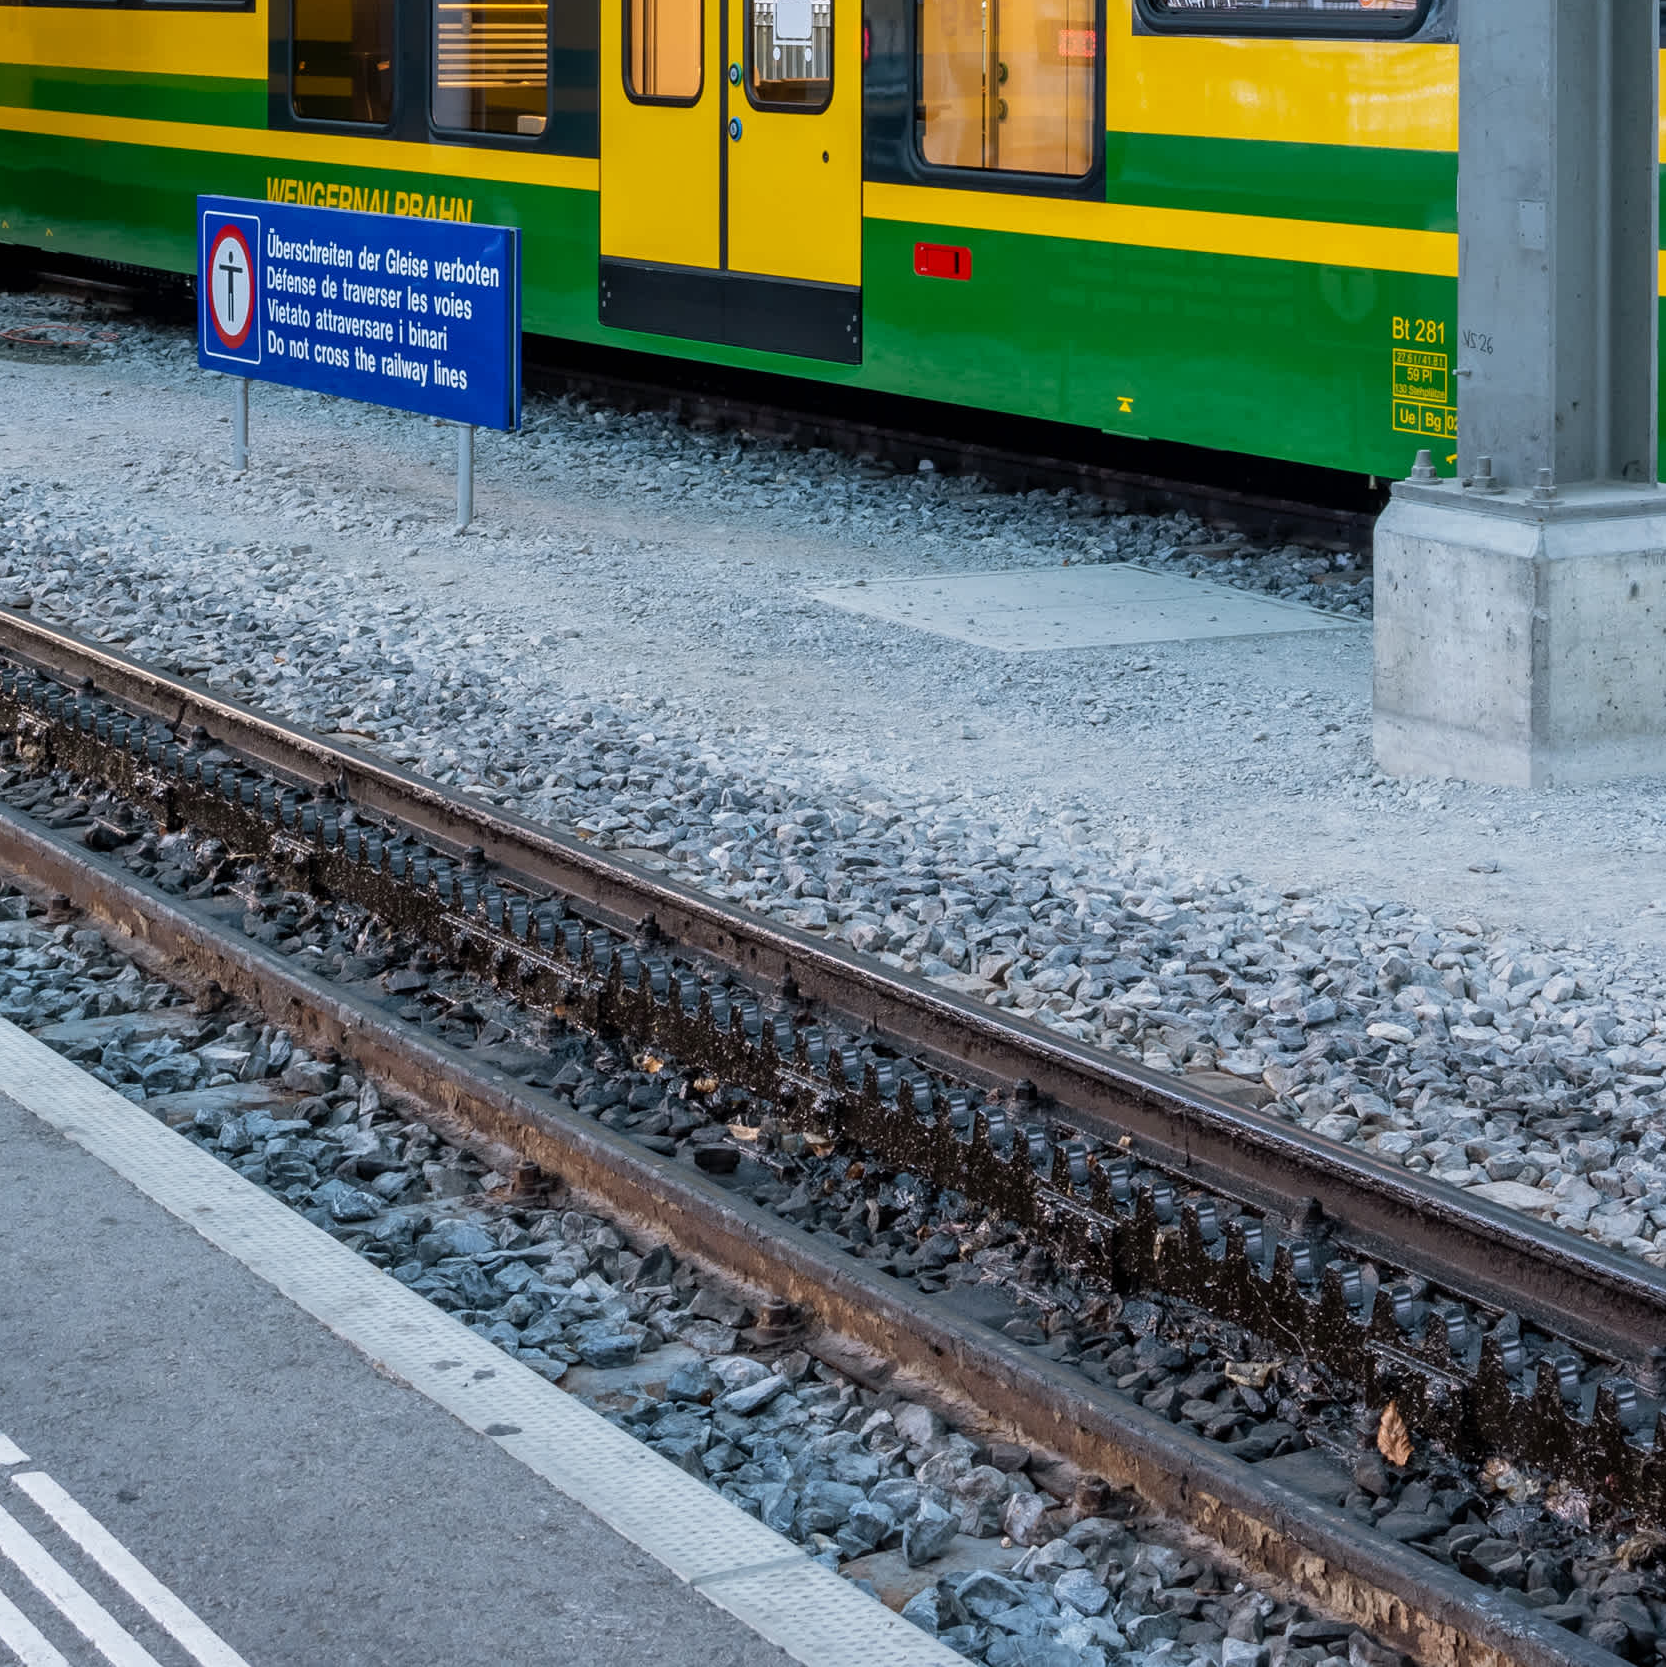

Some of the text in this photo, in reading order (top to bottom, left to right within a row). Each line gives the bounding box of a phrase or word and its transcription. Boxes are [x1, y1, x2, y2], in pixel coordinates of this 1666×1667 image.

[267, 227, 500, 288] Überschreiten der Gleise verboten
[267, 265, 473, 320] Défense de traverser les voies
[267, 297, 448, 352] Vietato attraversare i binari
[1392, 316, 1445, 345] Bt 281
[267, 329, 468, 390] Do not cross the railway lines
[1406, 367, 1420, 382] 59
[1399, 407, 1416, 425] Ue
[1425, 412, 1442, 432] Bg
